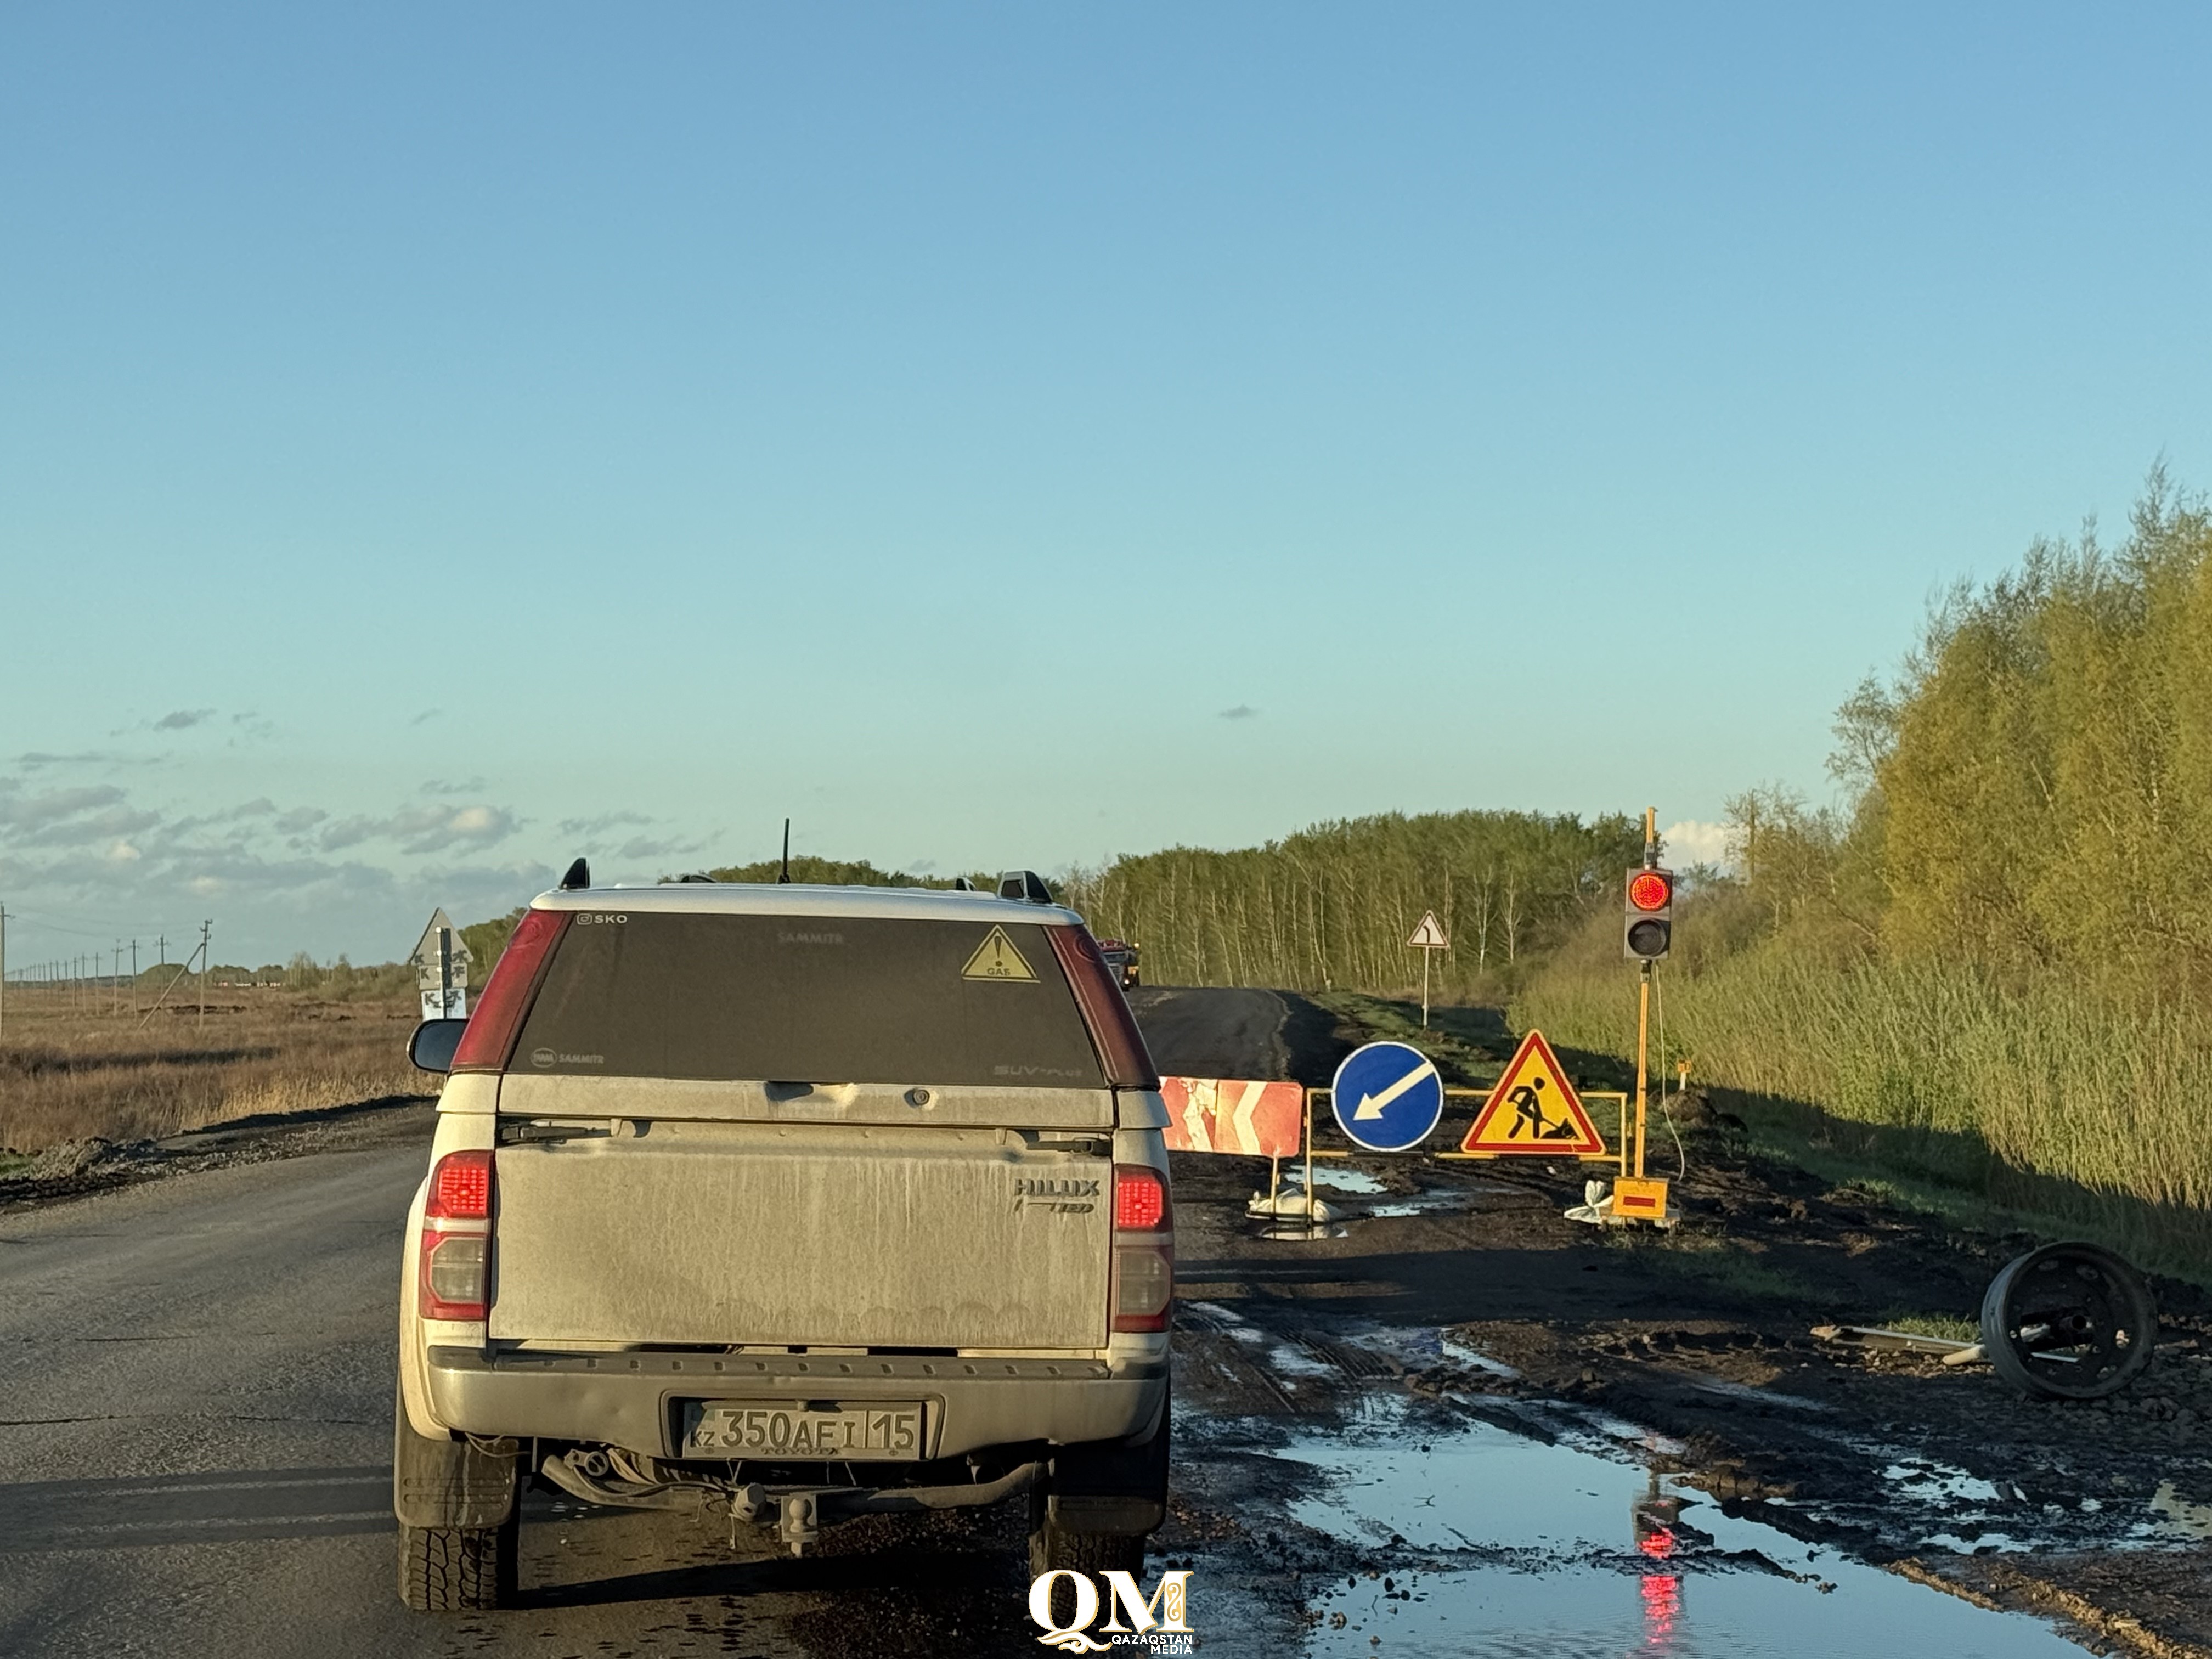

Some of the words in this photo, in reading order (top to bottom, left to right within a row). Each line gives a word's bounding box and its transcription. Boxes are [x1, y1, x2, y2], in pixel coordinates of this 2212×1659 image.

[594, 915, 628, 924] SKO
[986, 967, 1011, 976] GAS
[558, 1053, 605, 1064] SAMMITR
[1014, 1178, 1101, 1197] HILUX
[873, 1414, 916, 1450] 15
[761, 1447, 839, 1455] TOYOTA
